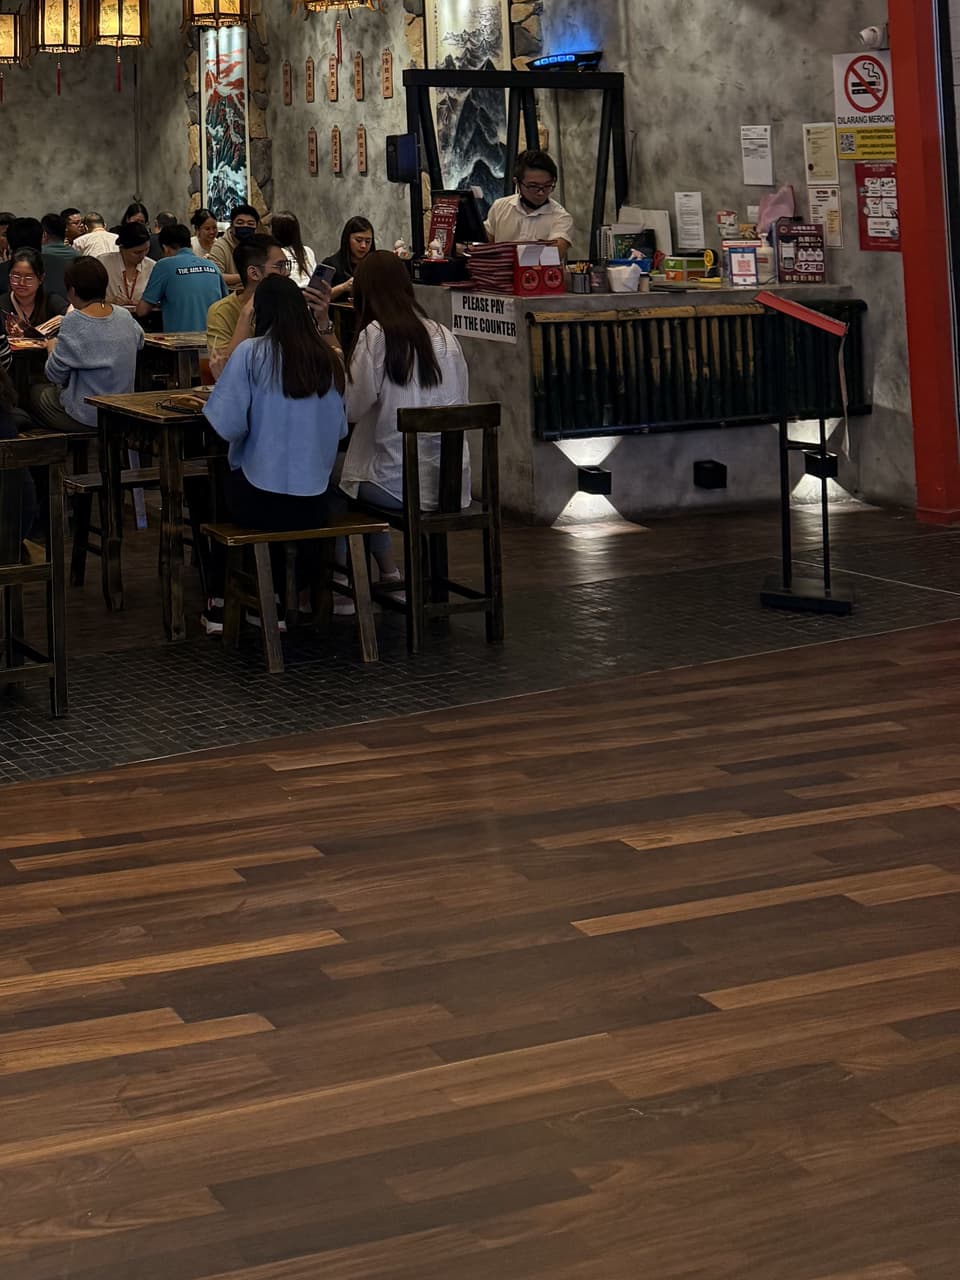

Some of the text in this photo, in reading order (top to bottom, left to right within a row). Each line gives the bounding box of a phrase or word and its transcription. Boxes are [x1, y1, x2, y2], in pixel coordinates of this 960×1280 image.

[837, 116, 868, 125] DILARANG
[462, 295, 505, 314] PLEASE PAY
[453, 314, 516, 337] AT THE COUNTER
